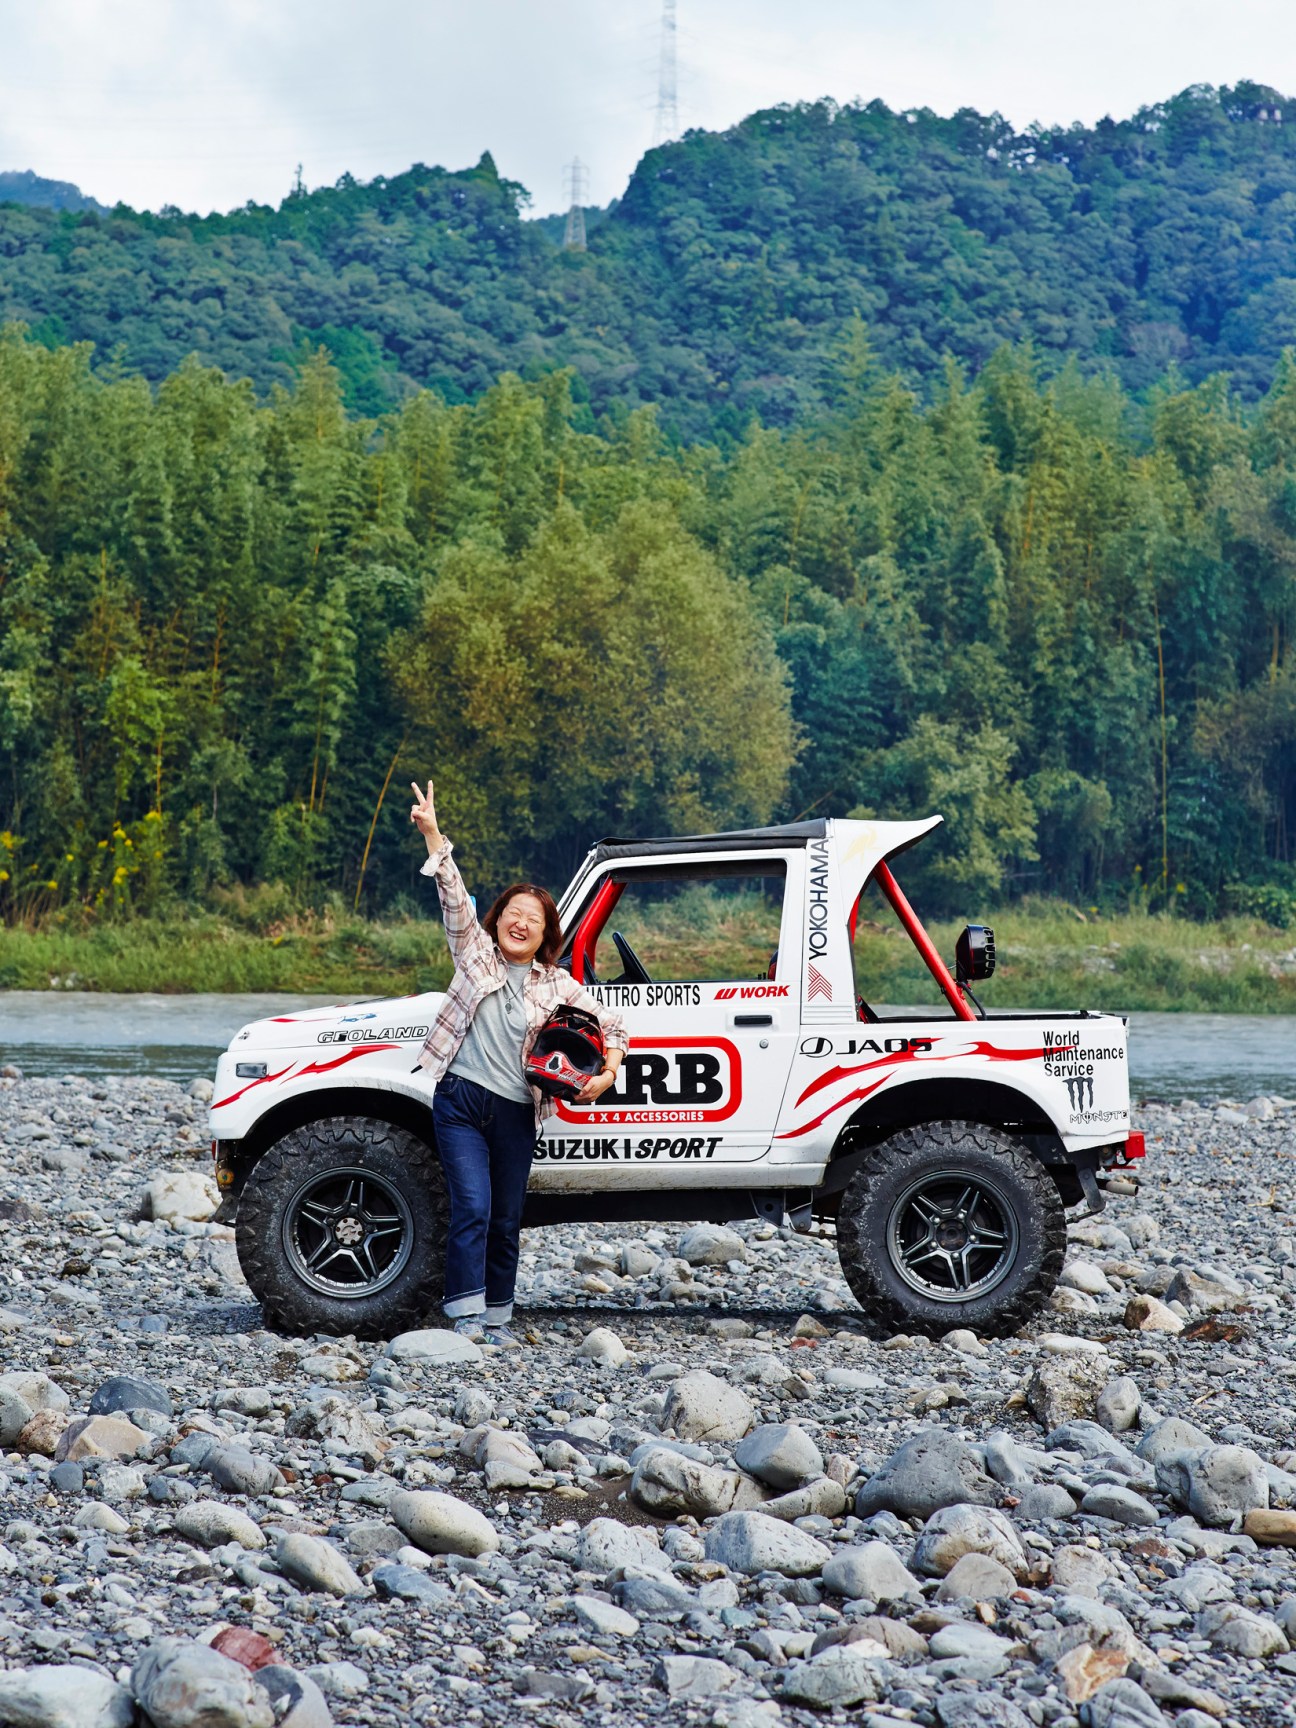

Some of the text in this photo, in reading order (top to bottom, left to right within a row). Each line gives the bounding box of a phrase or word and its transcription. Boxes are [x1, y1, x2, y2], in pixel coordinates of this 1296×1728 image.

[808, 838, 829, 961] YOKOHAMA
[586, 985, 701, 1007] ATTRO SPORTS
[740, 985, 790, 999] WORK
[836, 1037, 932, 1054] JAOS
[1043, 1030, 1080, 1046] World
[1043, 1047, 1124, 1062] Maintenance
[1044, 1062, 1094, 1077] Sarvice
[587, 1112, 596, 1122] 4
[612, 1112, 621, 1122] 4
[624, 1111, 704, 1122] ACCESSORIES
[533, 1137, 724, 1160] SUZUKI SPORT
